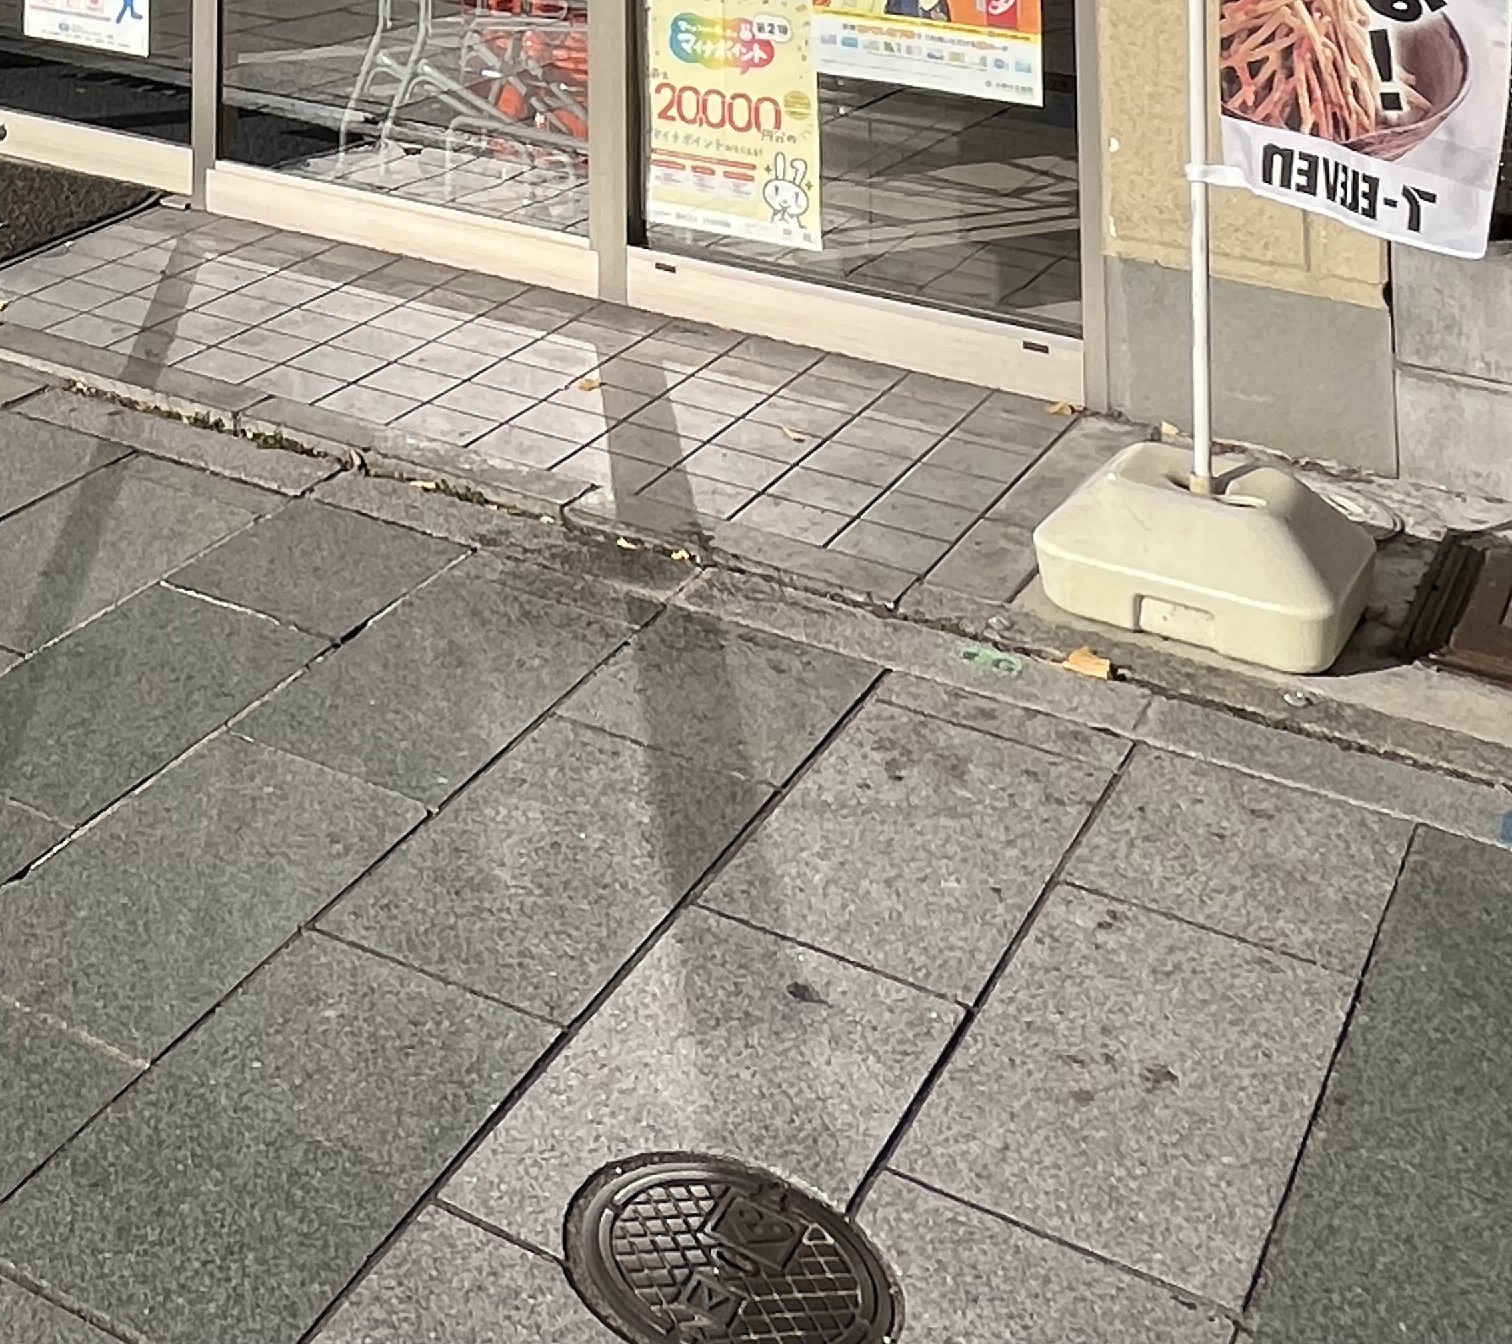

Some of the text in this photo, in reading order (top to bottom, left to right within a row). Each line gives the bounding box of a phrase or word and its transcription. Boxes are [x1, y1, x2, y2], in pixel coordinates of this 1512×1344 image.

[676, 32, 768, 64] マイナポイント
[654, 81, 783, 134] 20,000
